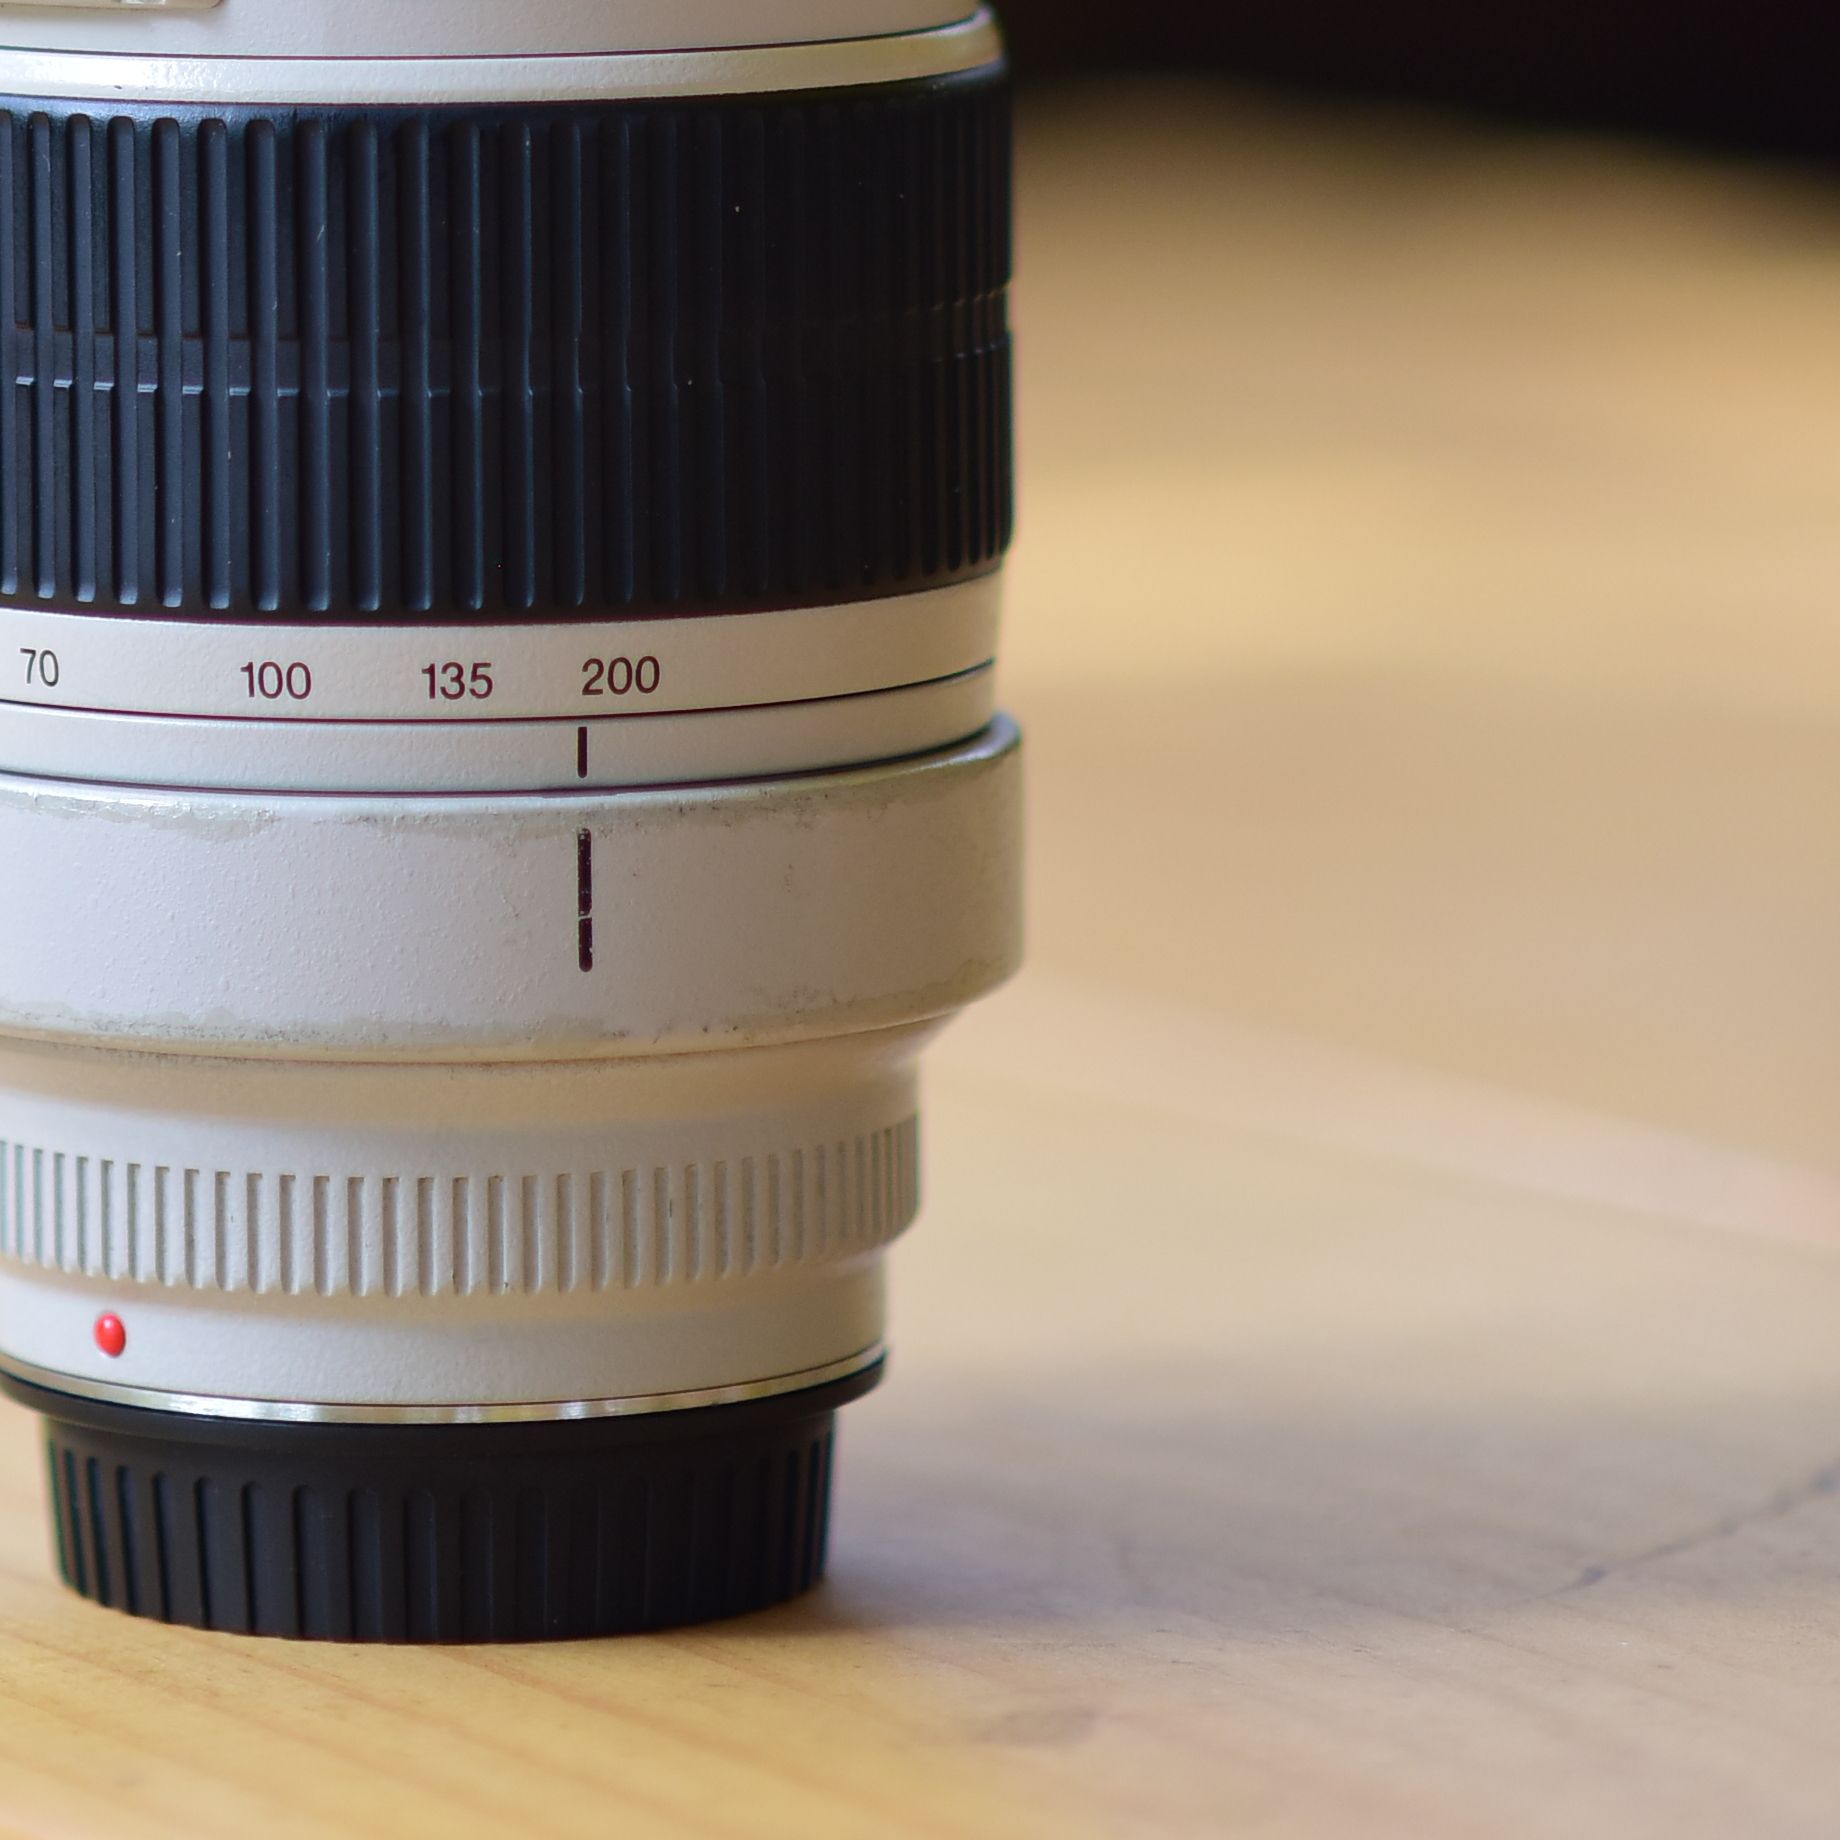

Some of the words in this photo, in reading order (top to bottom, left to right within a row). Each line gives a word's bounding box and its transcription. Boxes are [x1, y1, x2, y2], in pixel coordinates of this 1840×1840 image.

[20, 647, 60, 688] 70
[240, 660, 313, 700] 100
[421, 660, 495, 700] 135
[581, 655, 661, 697] 200
